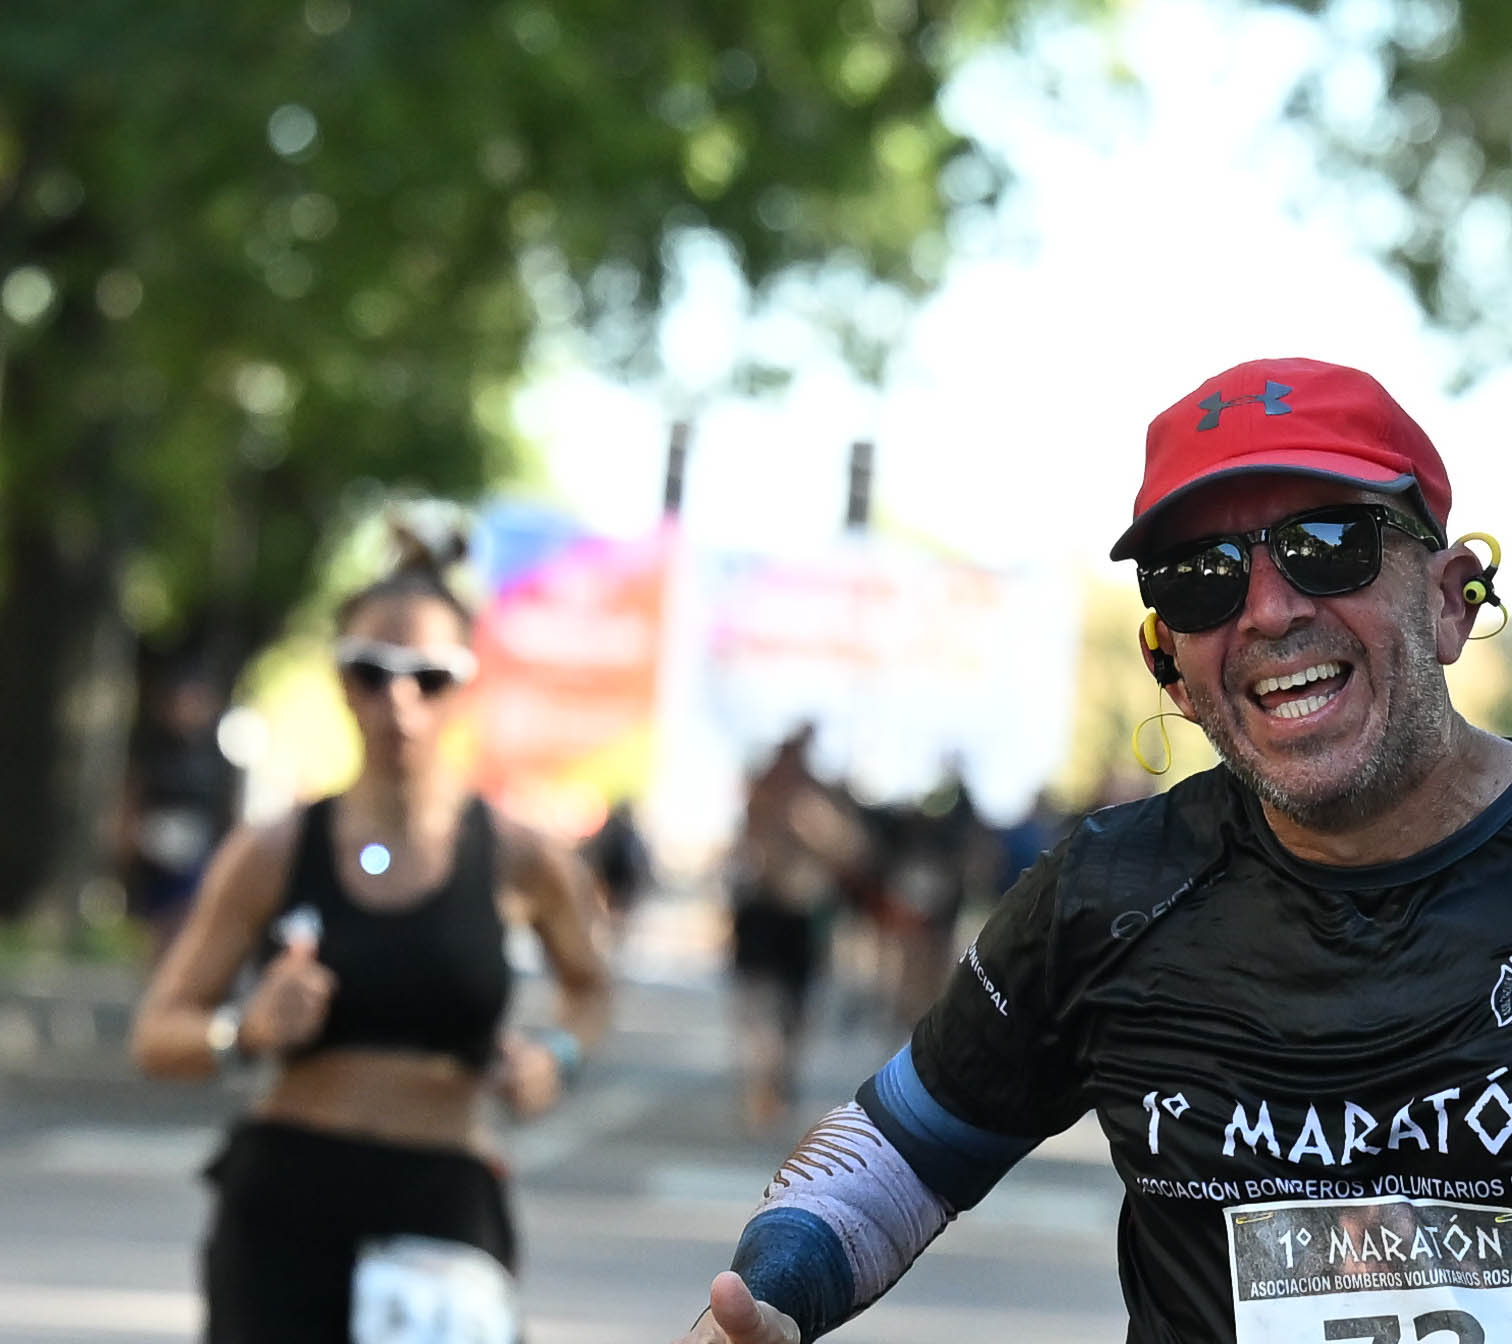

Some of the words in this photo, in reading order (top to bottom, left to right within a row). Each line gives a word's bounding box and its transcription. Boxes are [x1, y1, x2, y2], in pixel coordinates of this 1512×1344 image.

[1371, 1174, 1506, 1200] VOLUNTARIOS
[1328, 1213, 1504, 1266] MARATÓN
[1250, 1275, 1331, 1298] ASOCIACION
[1334, 1270, 1403, 1291] BOMBEROS
[1404, 1267, 1481, 1288] VOLUNTARIOS
